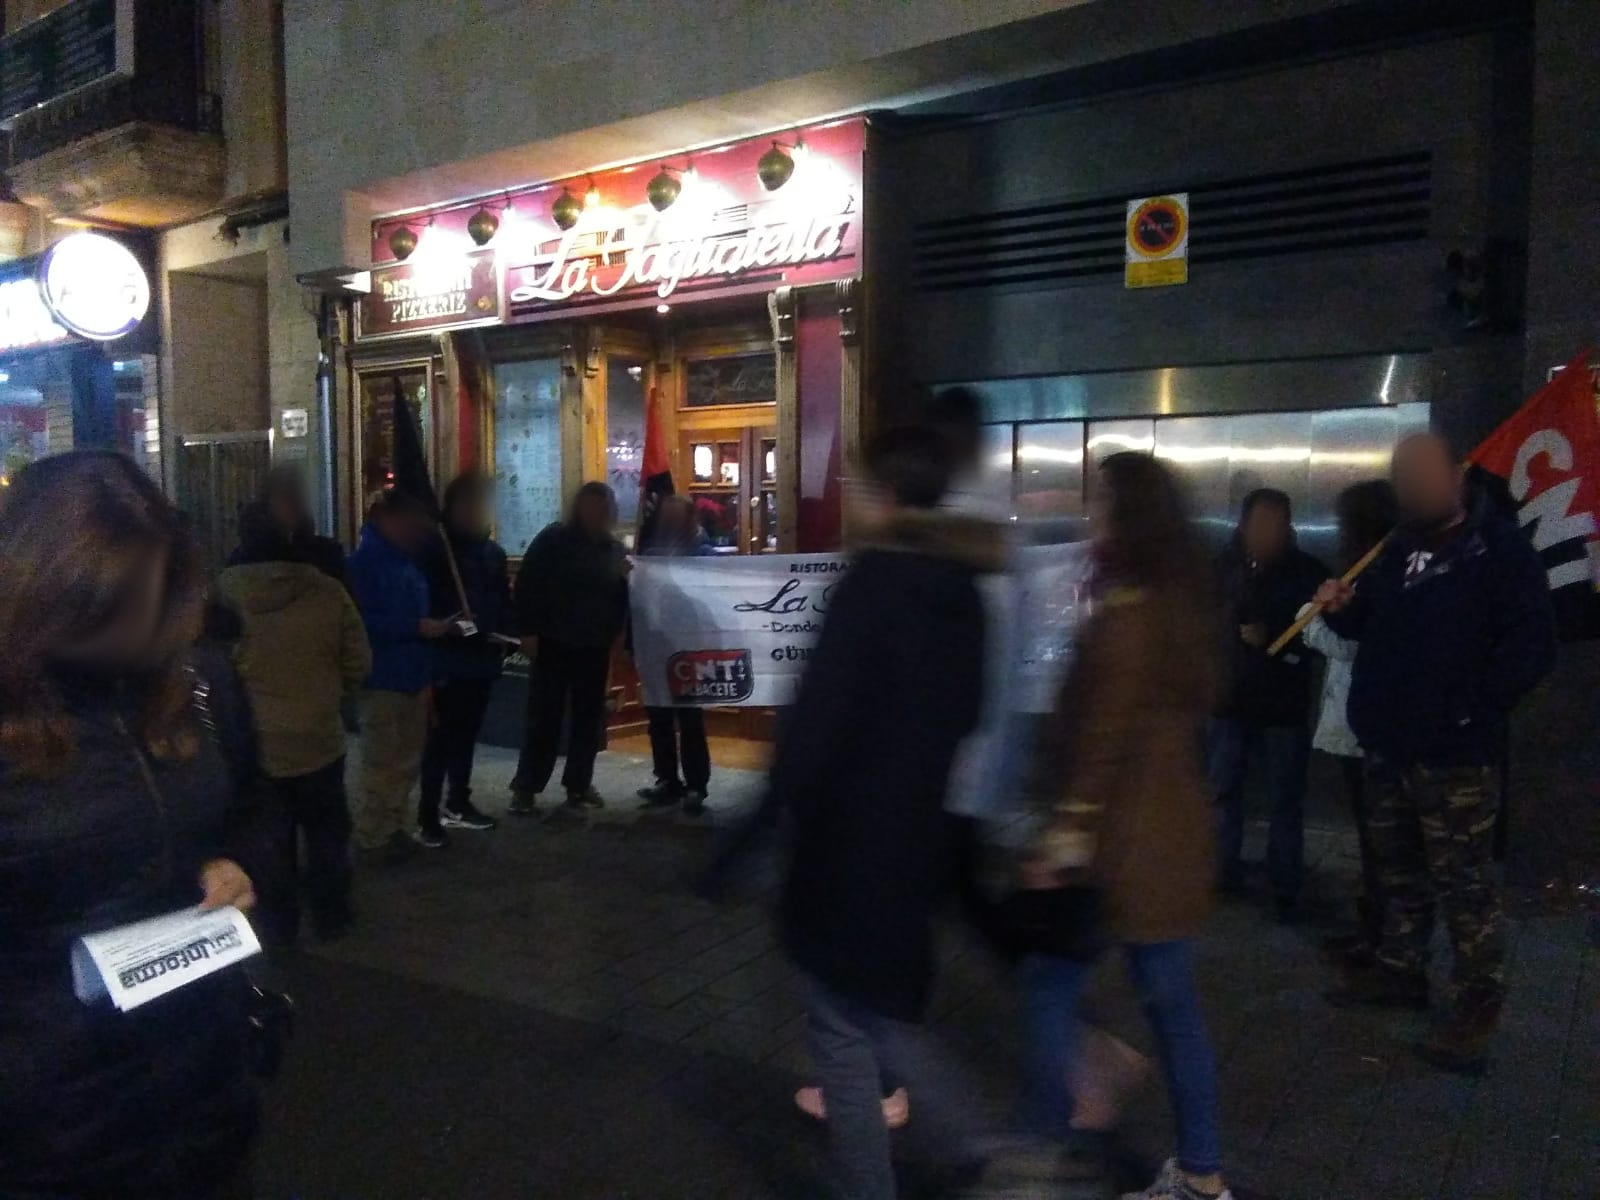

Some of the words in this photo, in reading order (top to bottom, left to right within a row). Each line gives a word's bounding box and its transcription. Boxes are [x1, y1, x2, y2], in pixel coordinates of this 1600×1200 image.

[511, 222, 588, 301] La
[789, 562, 852, 574] RISTORA
[733, 578, 808, 614] La
[673, 658, 737, 682] CNT
[118, 938, 211, 989] Informa
